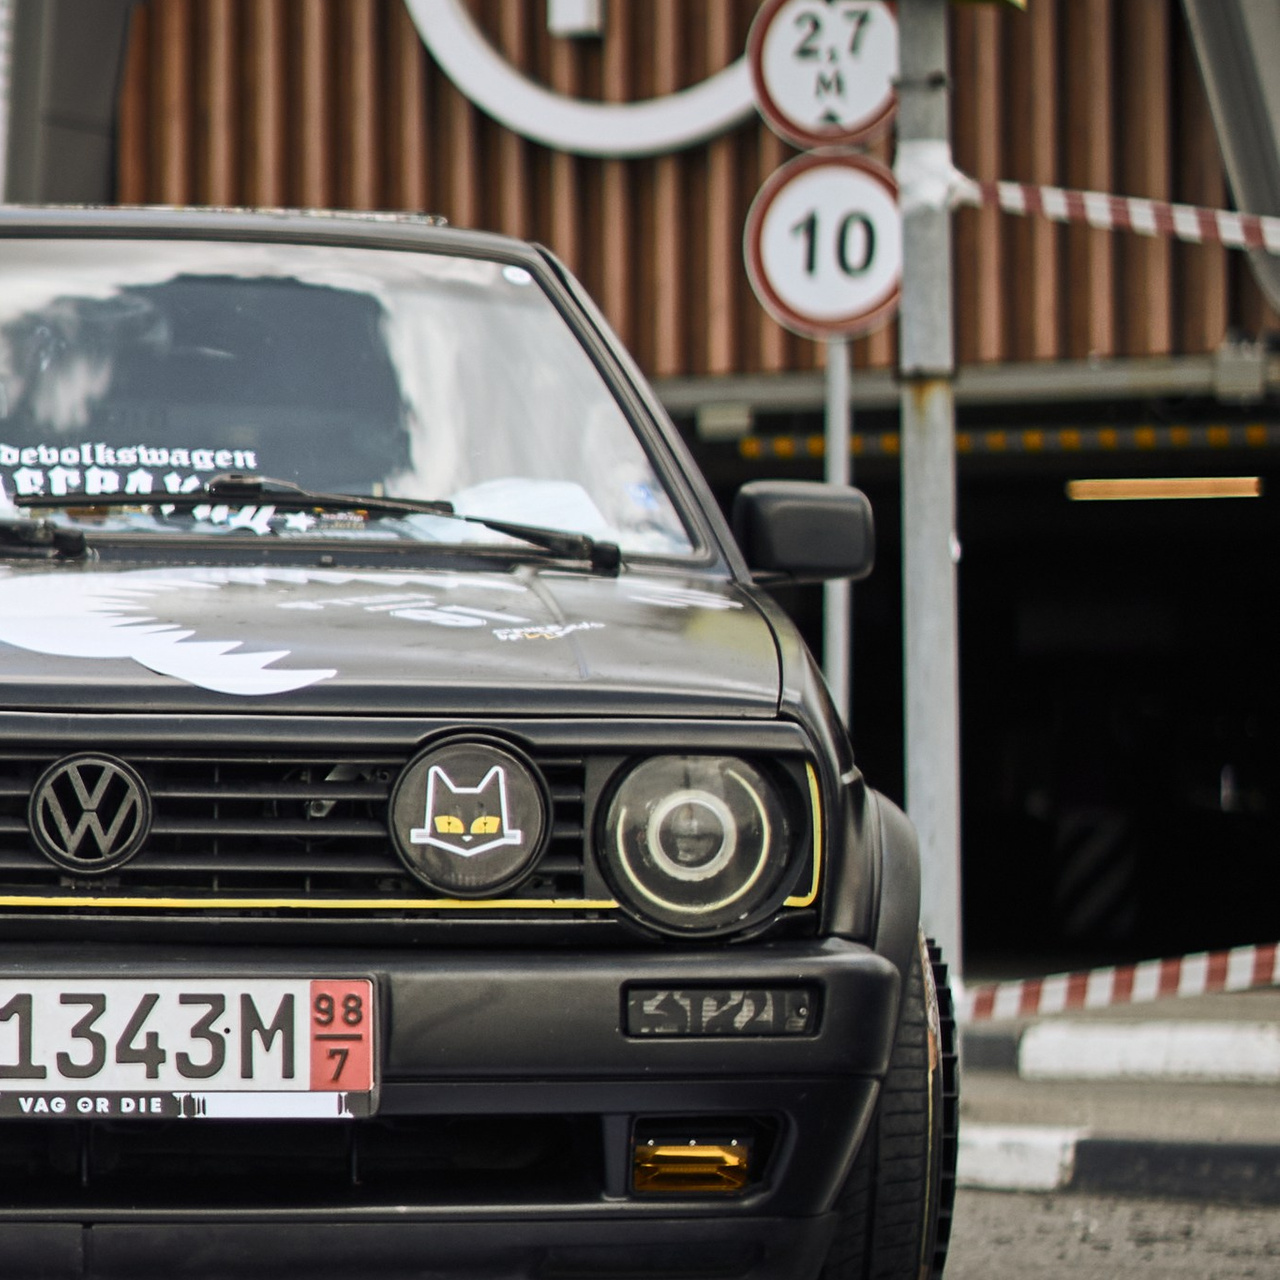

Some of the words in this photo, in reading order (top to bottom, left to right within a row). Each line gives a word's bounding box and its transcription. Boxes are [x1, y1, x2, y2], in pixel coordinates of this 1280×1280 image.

[793, 10, 871, 63] 2,7
[791, 210, 876, 278] 10
[36, 757, 144, 864] VW
[314, 992, 363, 1027] 98
[326, 1047, 350, 1083] 7
[18, 1096, 67, 1113] VAG
[76, 1096, 110, 1113] OR
[120, 1096, 163, 1113] DIE
